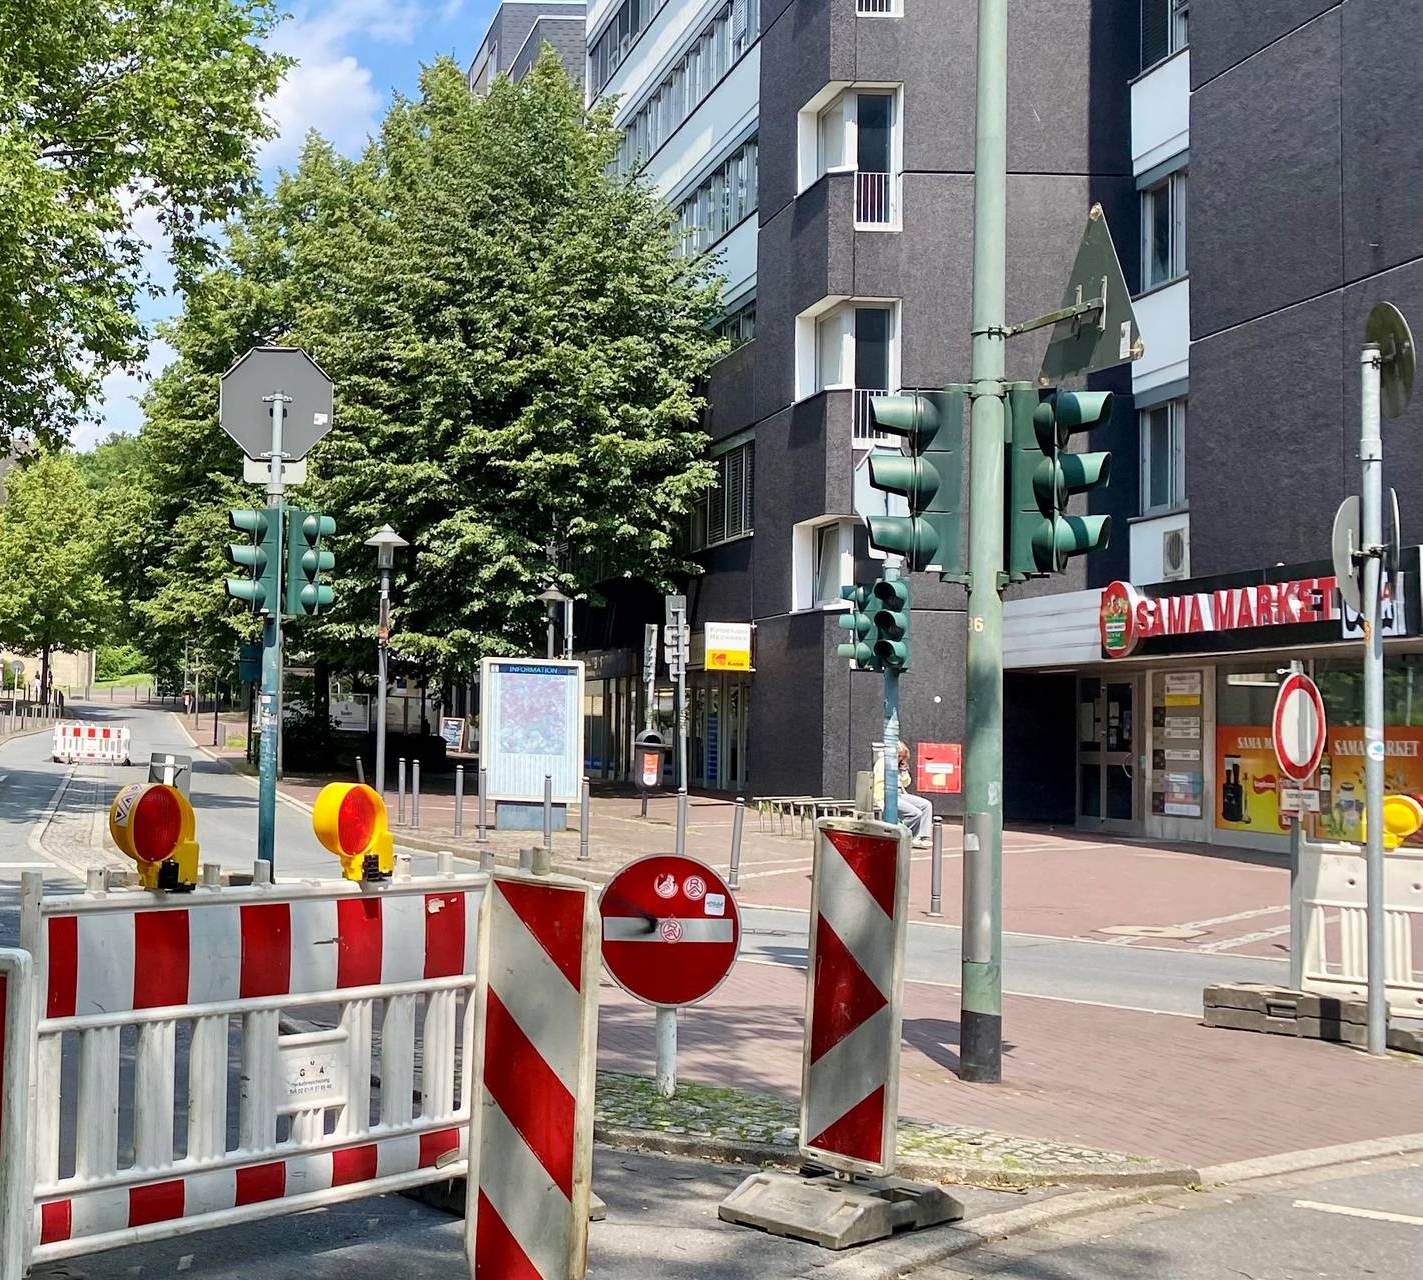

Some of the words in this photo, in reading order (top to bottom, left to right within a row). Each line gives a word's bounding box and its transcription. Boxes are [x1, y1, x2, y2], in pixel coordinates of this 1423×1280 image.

[1135, 592, 1207, 638] SAMA
[1213, 576, 1340, 631] MARKET
[509, 665, 558, 675] INFORMATION
[1237, 737, 1263, 749] SAMA
[1334, 739, 1366, 756] SAMA
